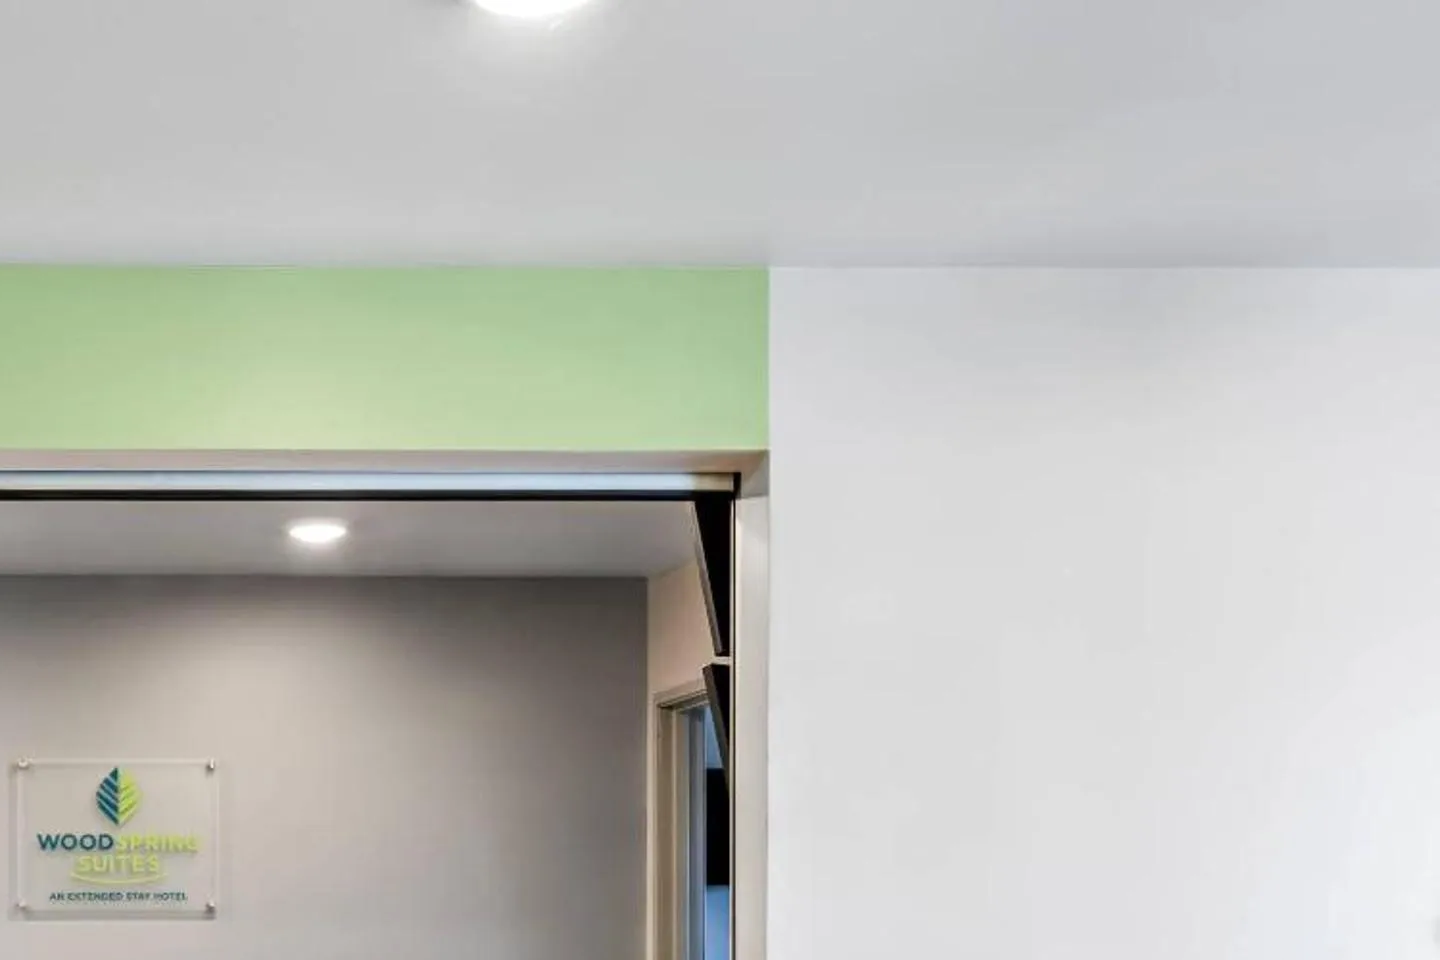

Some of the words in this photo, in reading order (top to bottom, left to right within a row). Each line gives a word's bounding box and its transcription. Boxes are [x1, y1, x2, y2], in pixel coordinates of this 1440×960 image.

[77, 856, 160, 873] SUITES
[49, 892, 65, 901] AN
[67, 892, 125, 901] EXTENDED
[126, 892, 152, 901] STAY
[153, 892, 188, 901] HOTEL
